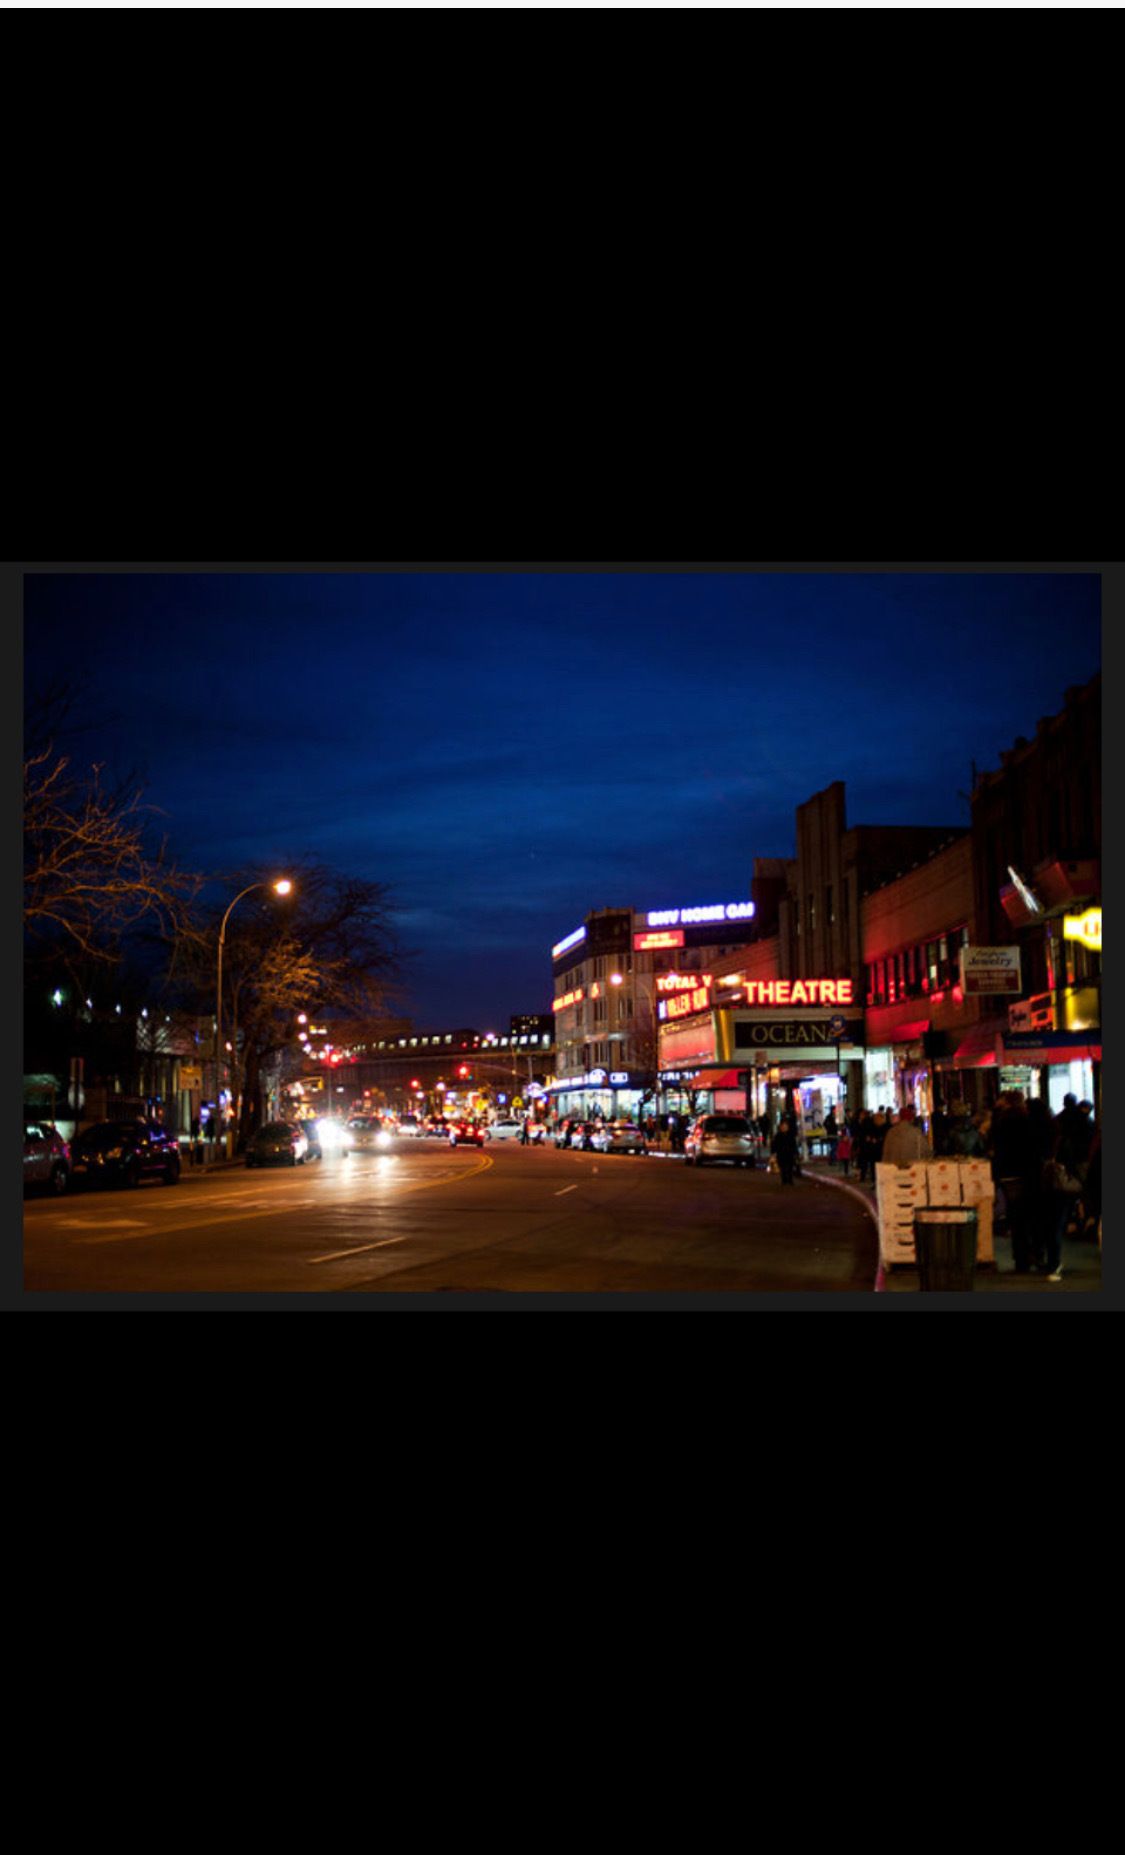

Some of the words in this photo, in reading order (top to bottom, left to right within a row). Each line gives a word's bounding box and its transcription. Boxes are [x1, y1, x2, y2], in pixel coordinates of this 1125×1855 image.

[968, 957, 1012, 967] Jewelry
[656, 974, 697, 991] TOTAL
[743, 978, 853, 1004] THEATRE
